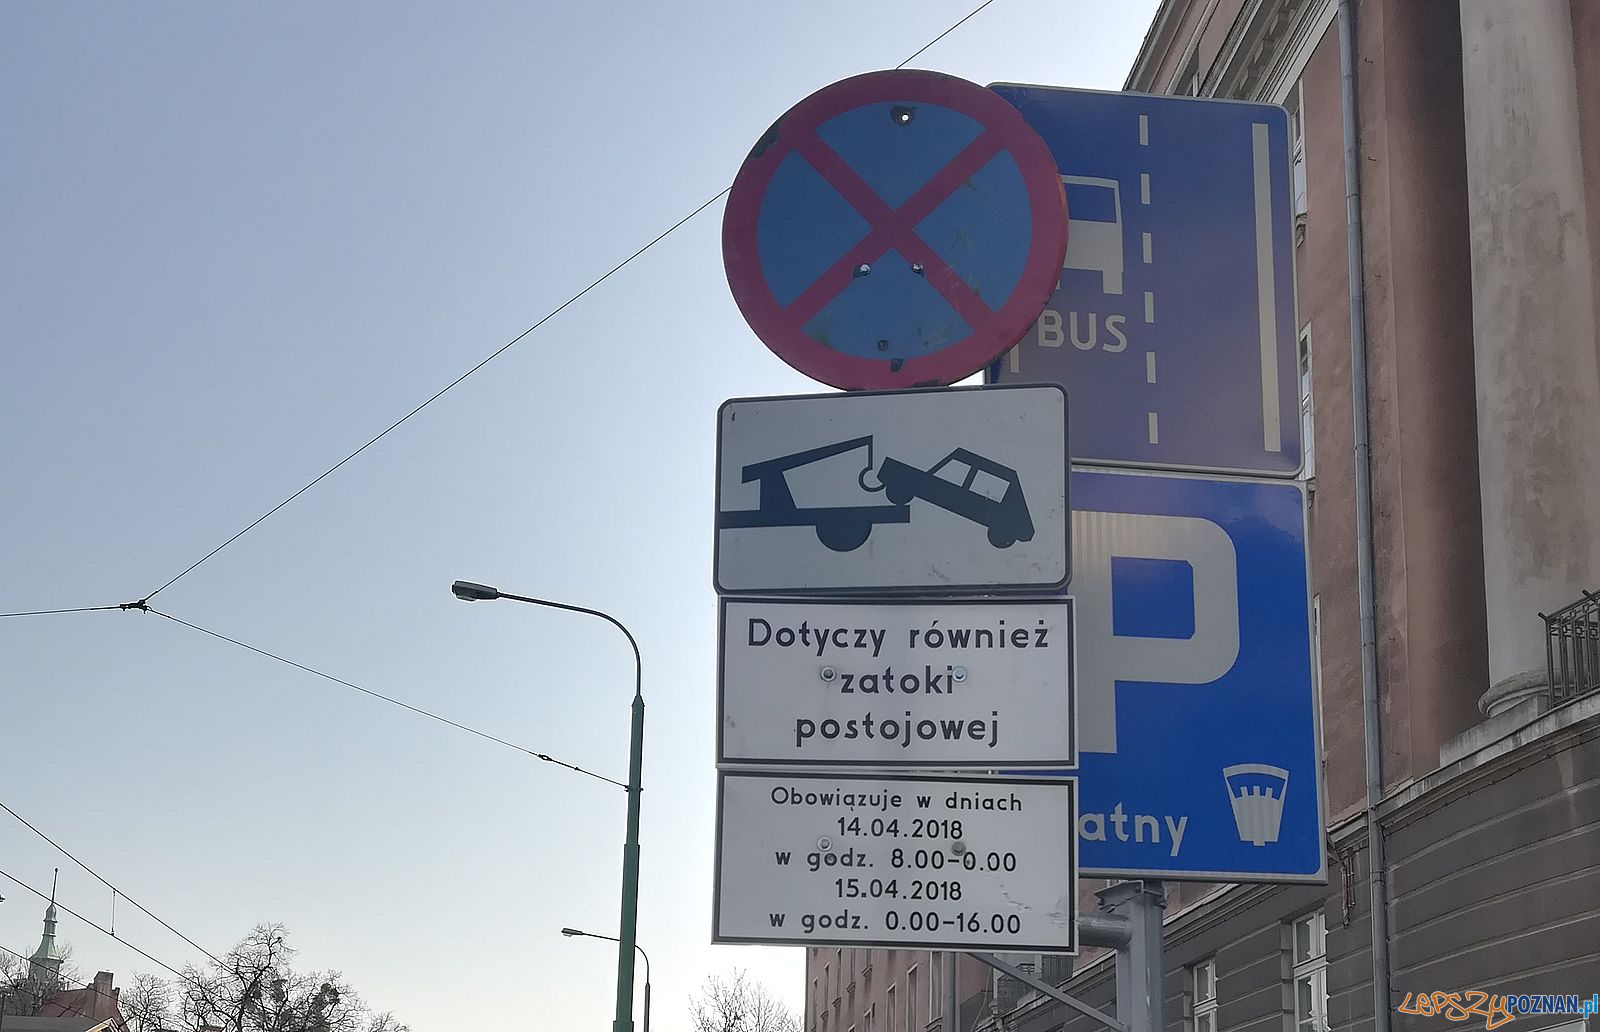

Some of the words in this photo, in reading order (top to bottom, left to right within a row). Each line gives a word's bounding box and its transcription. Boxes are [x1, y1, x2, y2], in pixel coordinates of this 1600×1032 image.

[1037, 309, 1128, 353] BUS
[748, 618, 886, 657] Dotyczy
[909, 619, 1049, 649] również
[1067, 509, 1241, 754] P
[840, 665, 954, 695] zatoki
[795, 710, 1000, 748] postojowej
[771, 786, 902, 812] Obowiązuje
[916, 795, 932, 809] w
[945, 791, 1023, 812] dniach
[837, 816, 963, 840] 14.04.2018
[1078, 801, 1189, 857] atny
[775, 851, 792, 866] w
[806, 847, 875, 872] godz.
[891, 848, 1017, 872] 8.00-0.00
[835, 878, 962, 901] 15.04.2018
[769, 913, 786, 928] w
[800, 909, 869, 934] godz.
[885, 910, 1021, 935] 0.00-16.00
